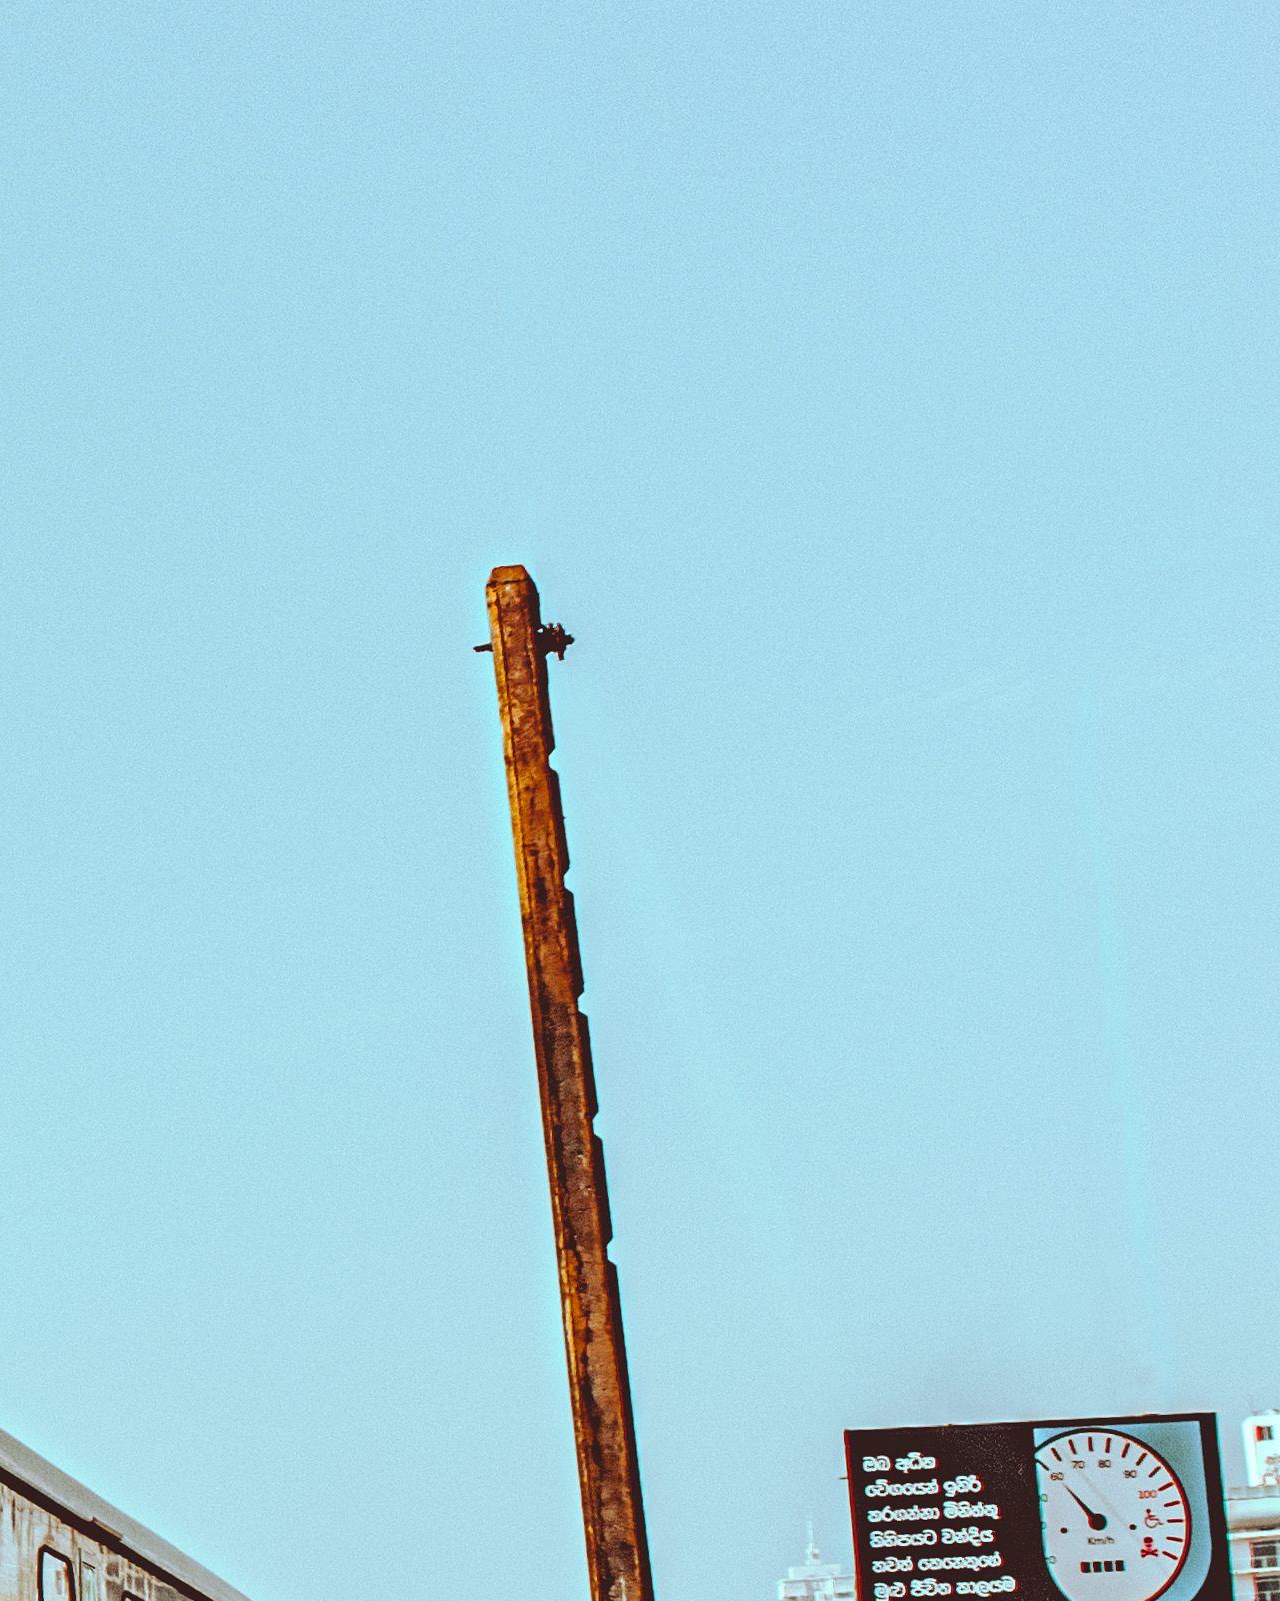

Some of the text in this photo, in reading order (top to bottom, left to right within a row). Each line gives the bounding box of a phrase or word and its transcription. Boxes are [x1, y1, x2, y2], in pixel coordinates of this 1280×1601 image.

[863, 1455, 891, 1472] ඔබ
[1072, 1460, 1085, 1469] 70
[1098, 1460, 1111, 1468] 80
[1050, 1472, 1064, 1480] 60
[1124, 1470, 1137, 1478] 90
[1139, 1490, 1157, 1499] 100
